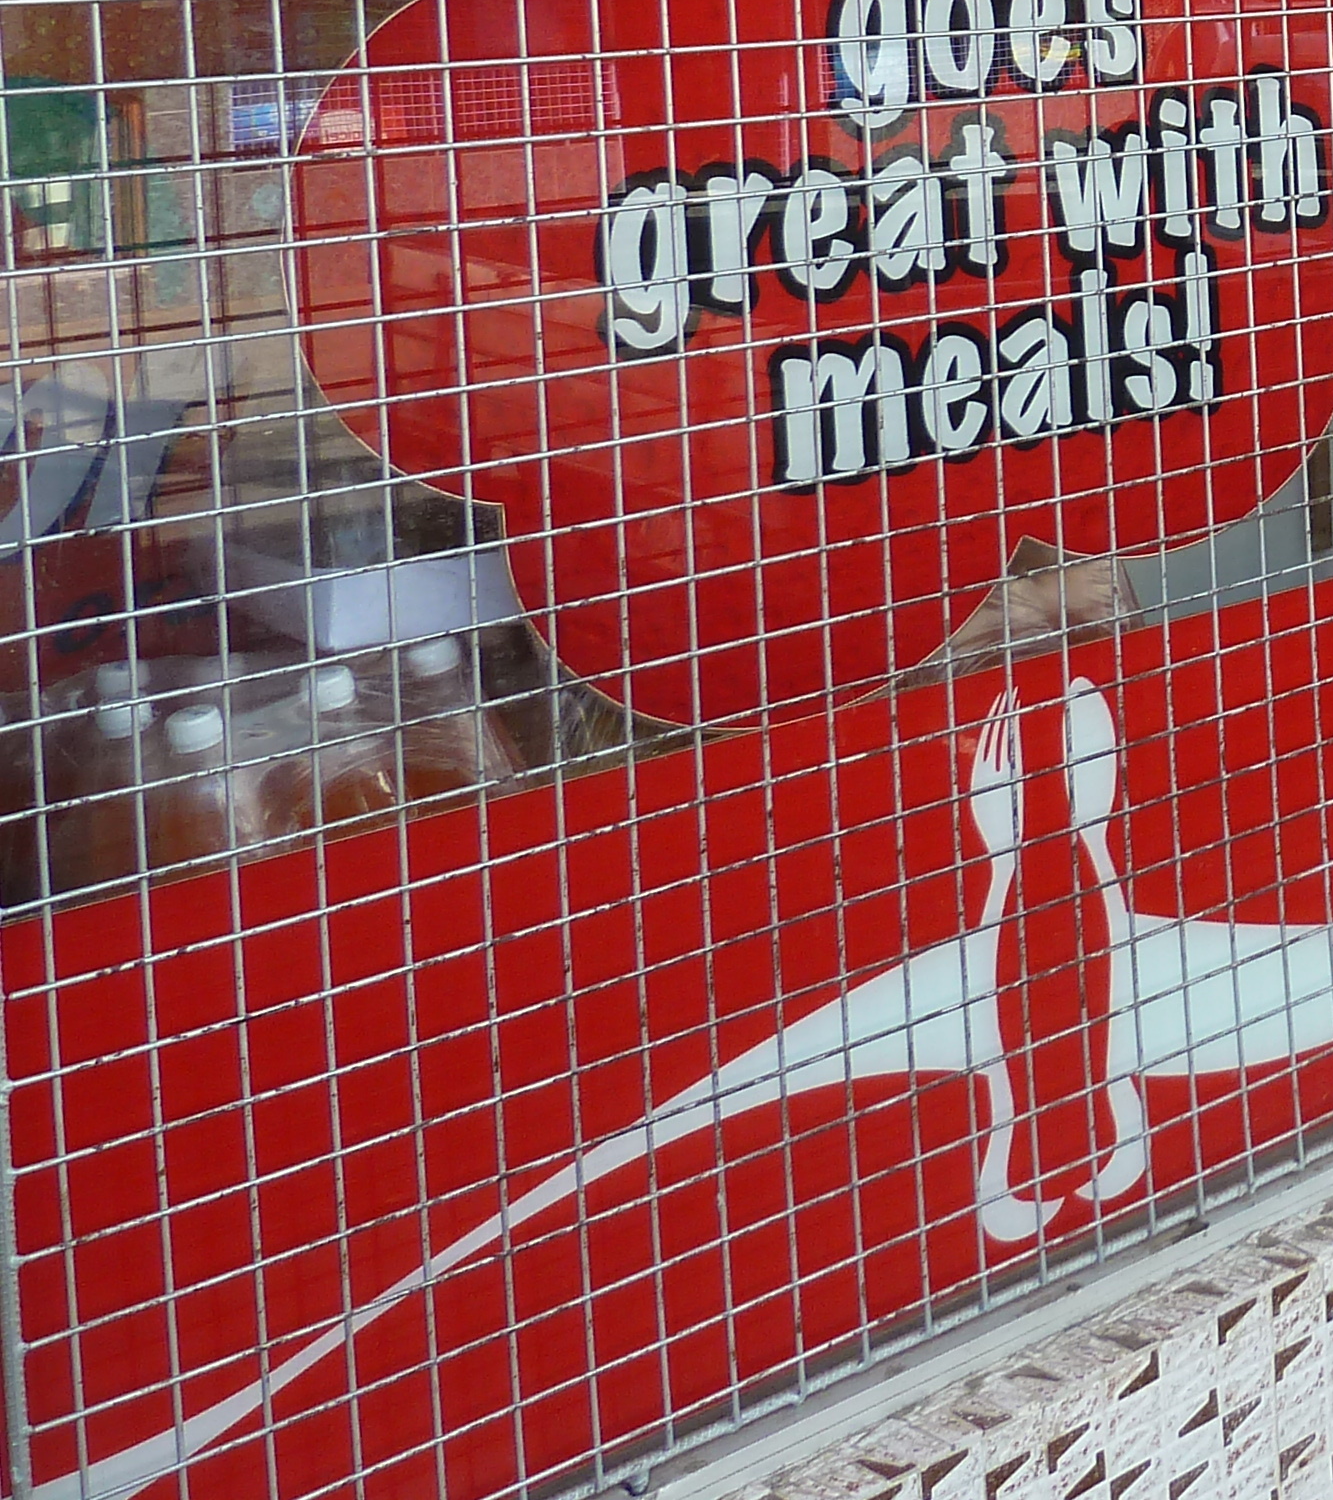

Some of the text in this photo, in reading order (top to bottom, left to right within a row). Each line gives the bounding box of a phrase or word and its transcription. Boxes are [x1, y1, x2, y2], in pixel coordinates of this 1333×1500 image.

[606, 75, 1322, 349] great with
[780, 252, 1214, 483] meals!
